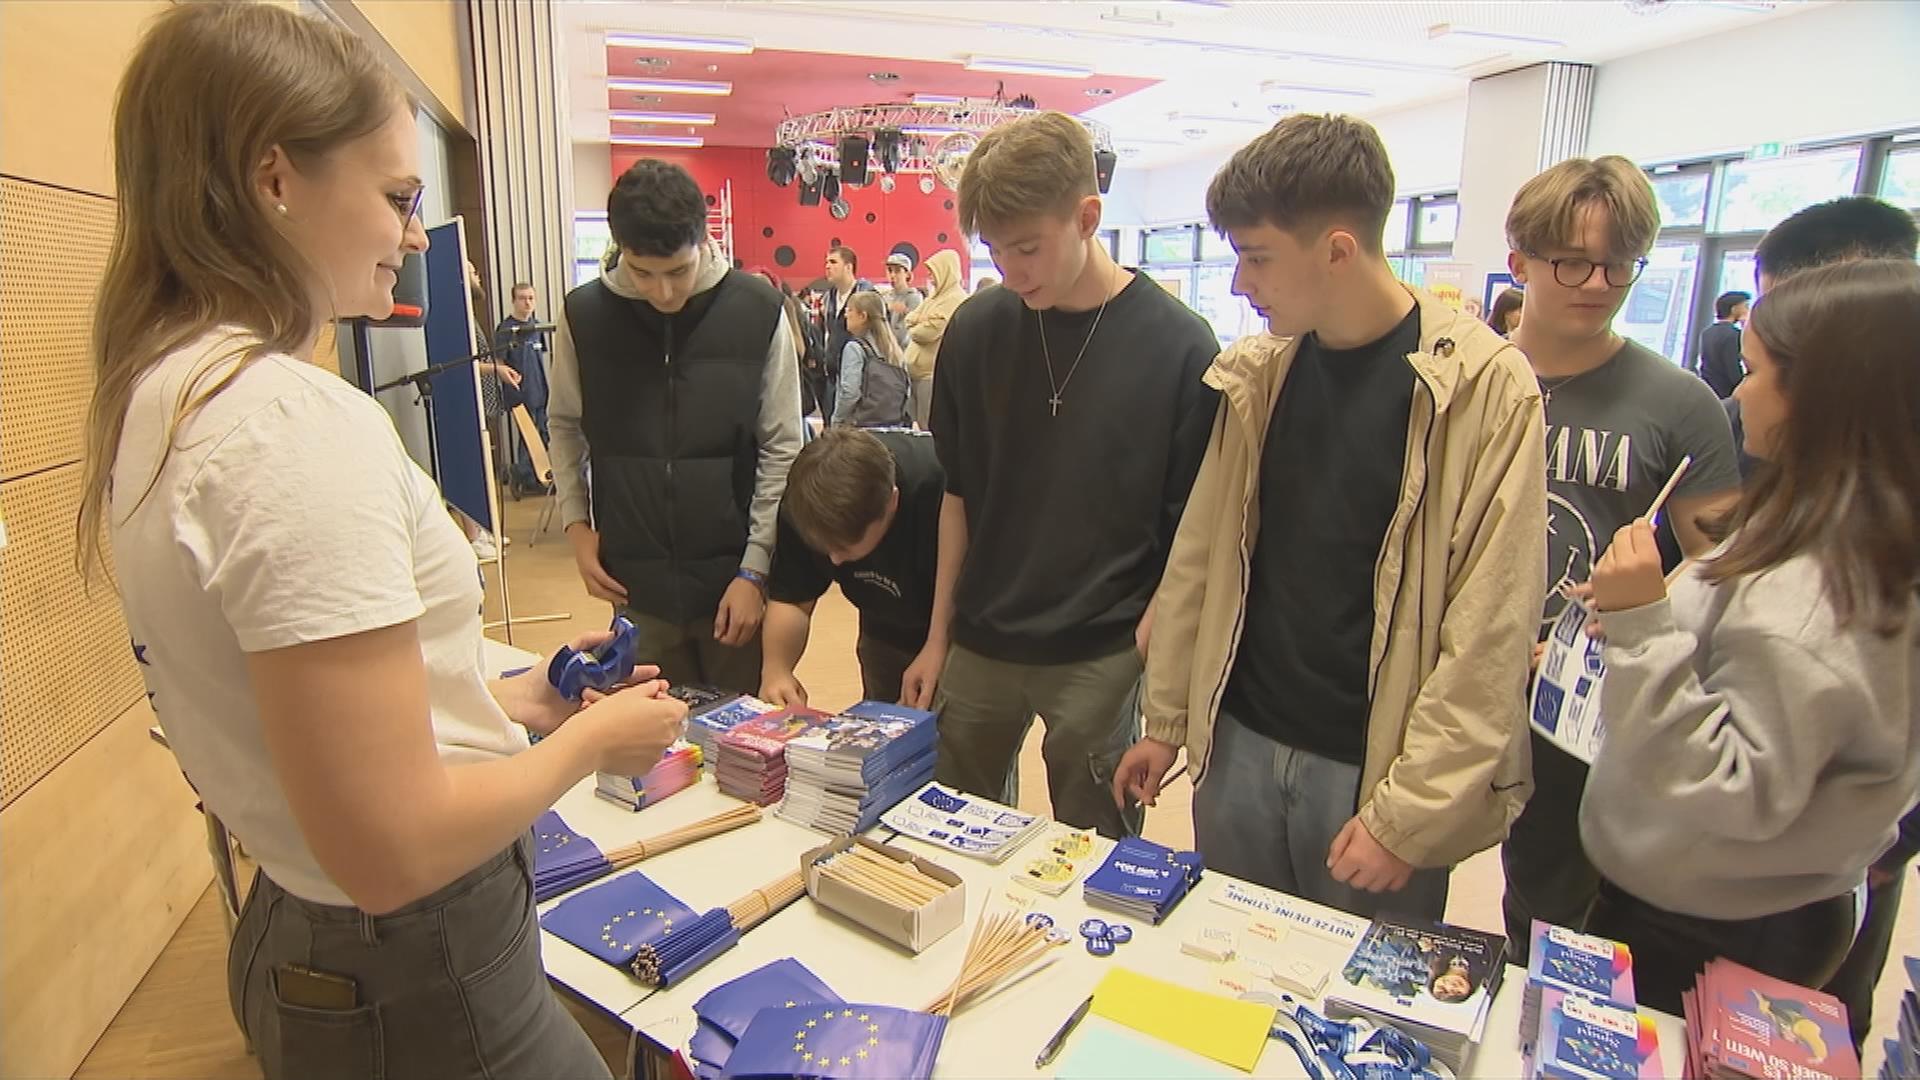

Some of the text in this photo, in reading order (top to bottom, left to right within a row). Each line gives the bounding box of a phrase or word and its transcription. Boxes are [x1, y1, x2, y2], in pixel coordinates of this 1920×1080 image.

[1226, 891, 1356, 939] NUTZE DEINE STIMME
